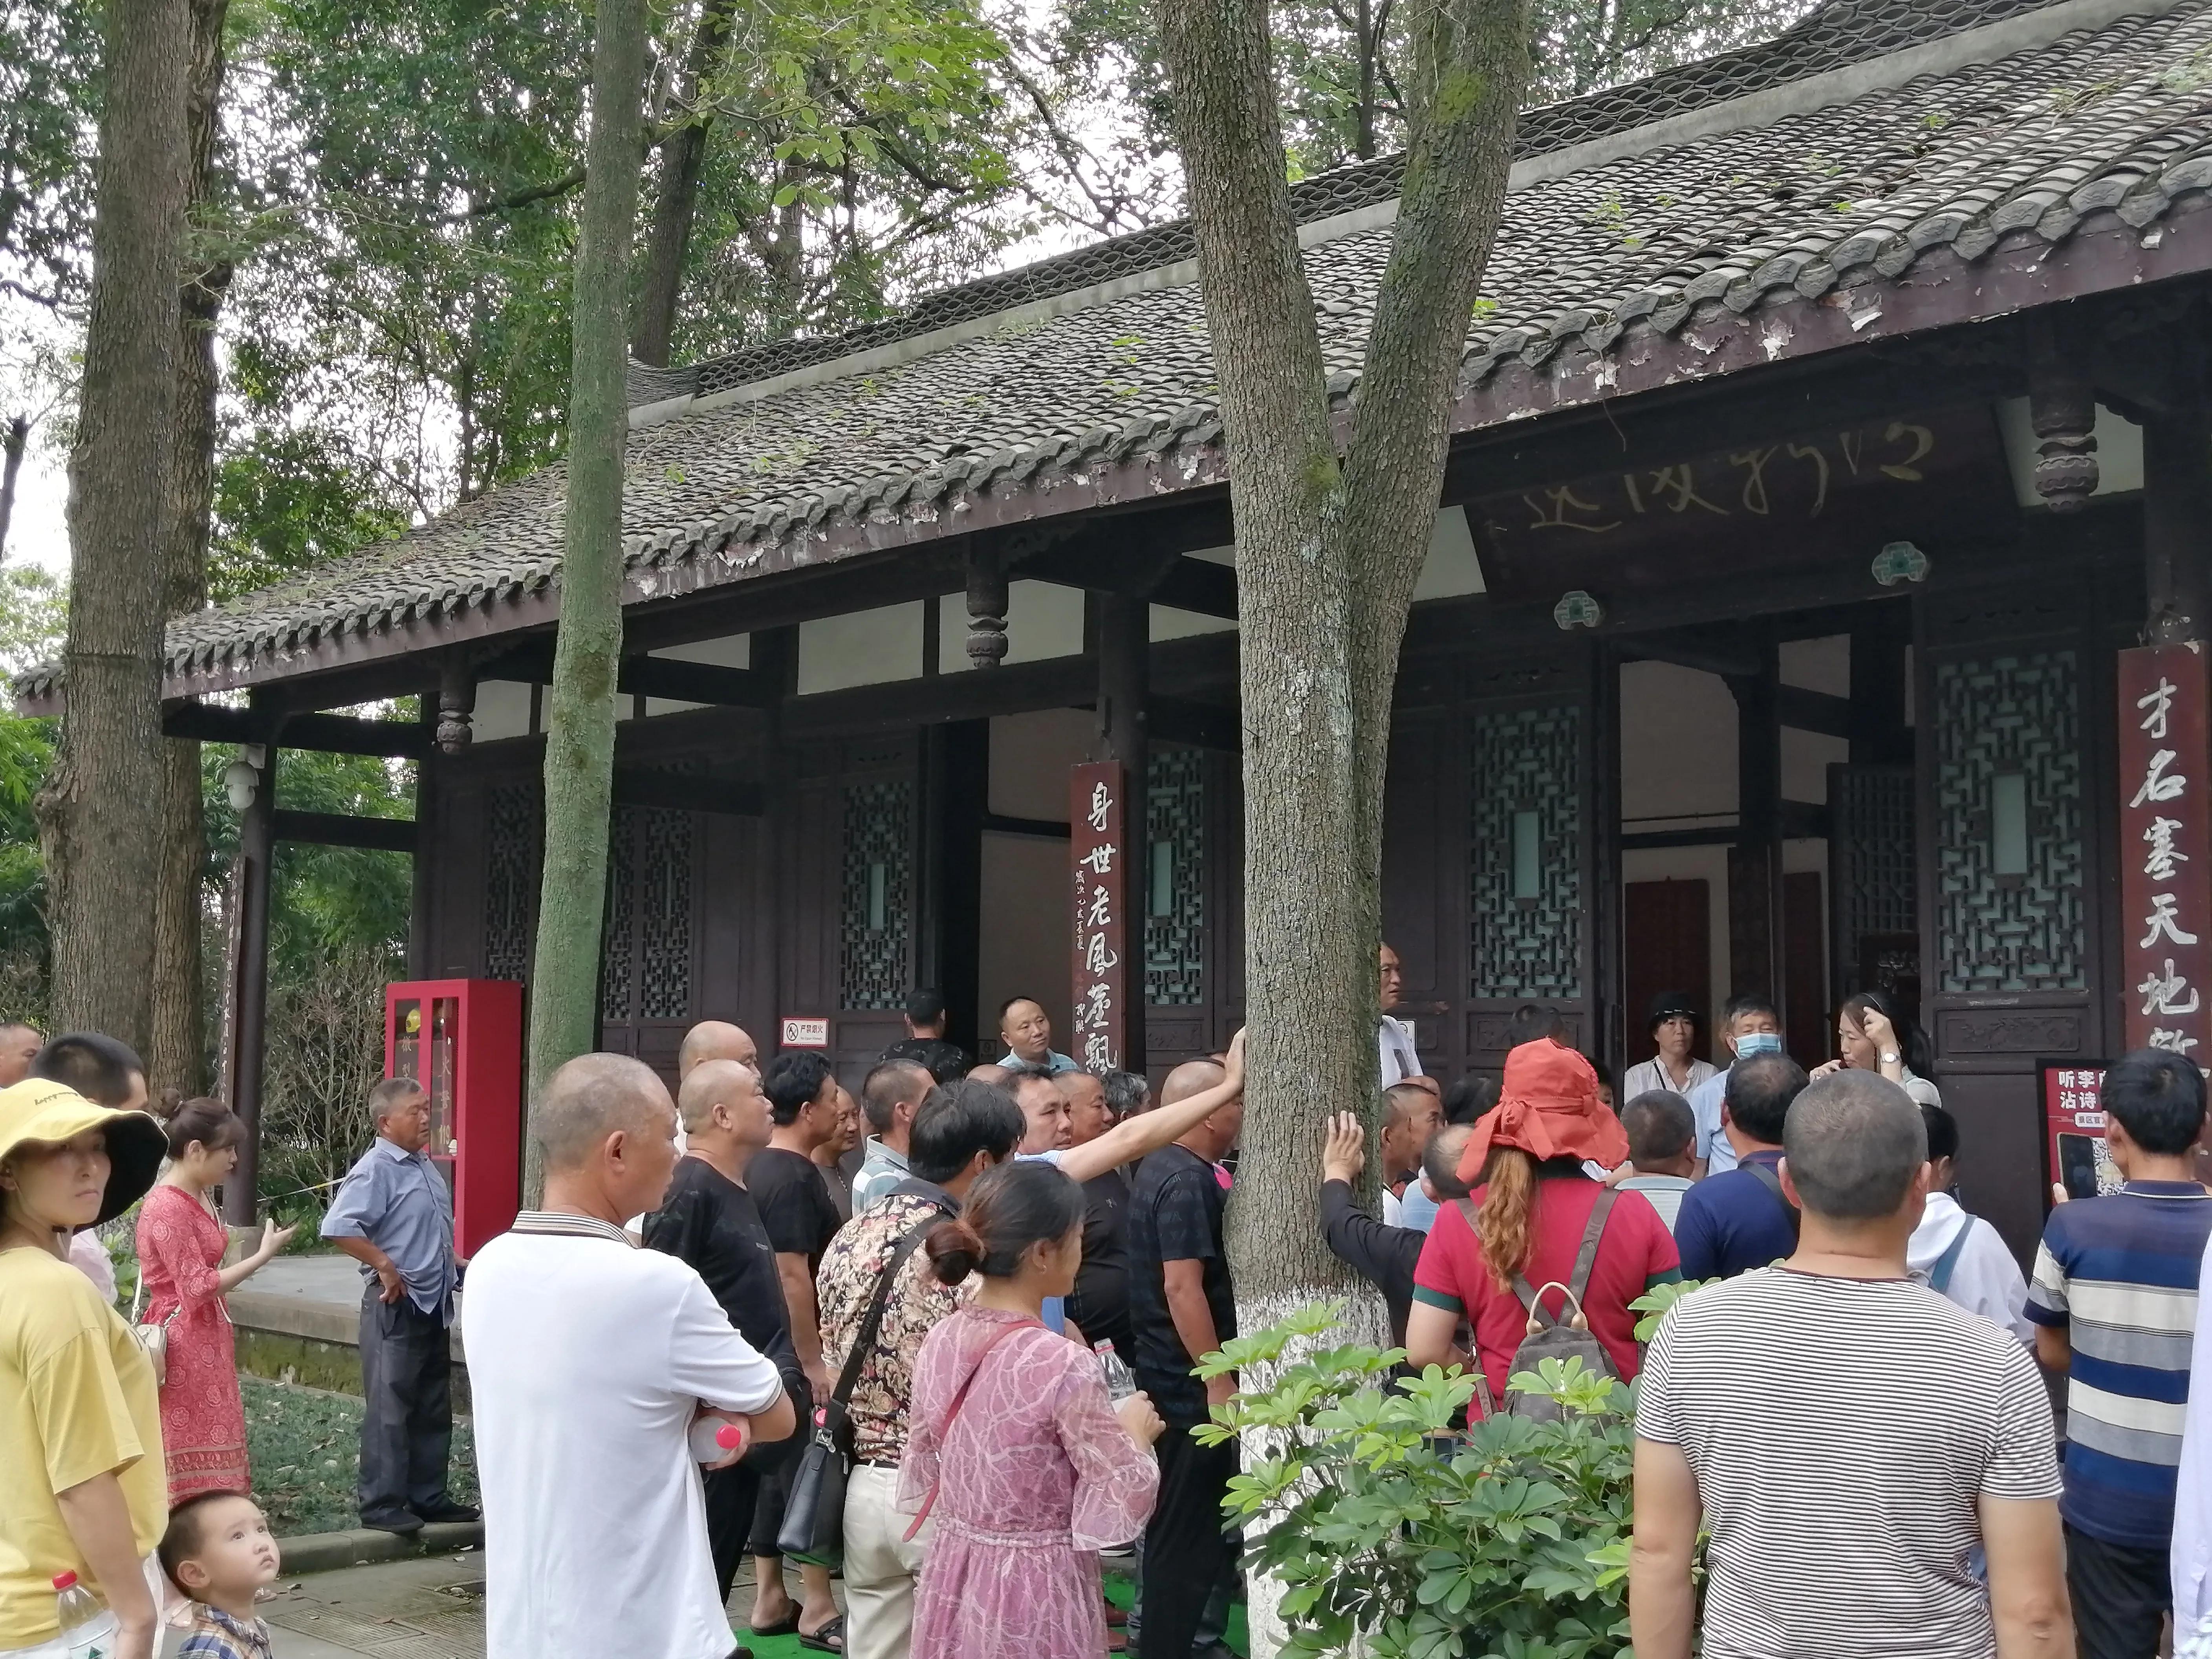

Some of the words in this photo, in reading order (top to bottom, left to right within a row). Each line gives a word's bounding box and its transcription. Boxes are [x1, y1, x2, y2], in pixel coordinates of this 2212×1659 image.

[2058, 1070, 2107, 1088] 听李
[2059, 1091, 2097, 1110] 沾诗
[439, 1124, 450, 1145] 119
